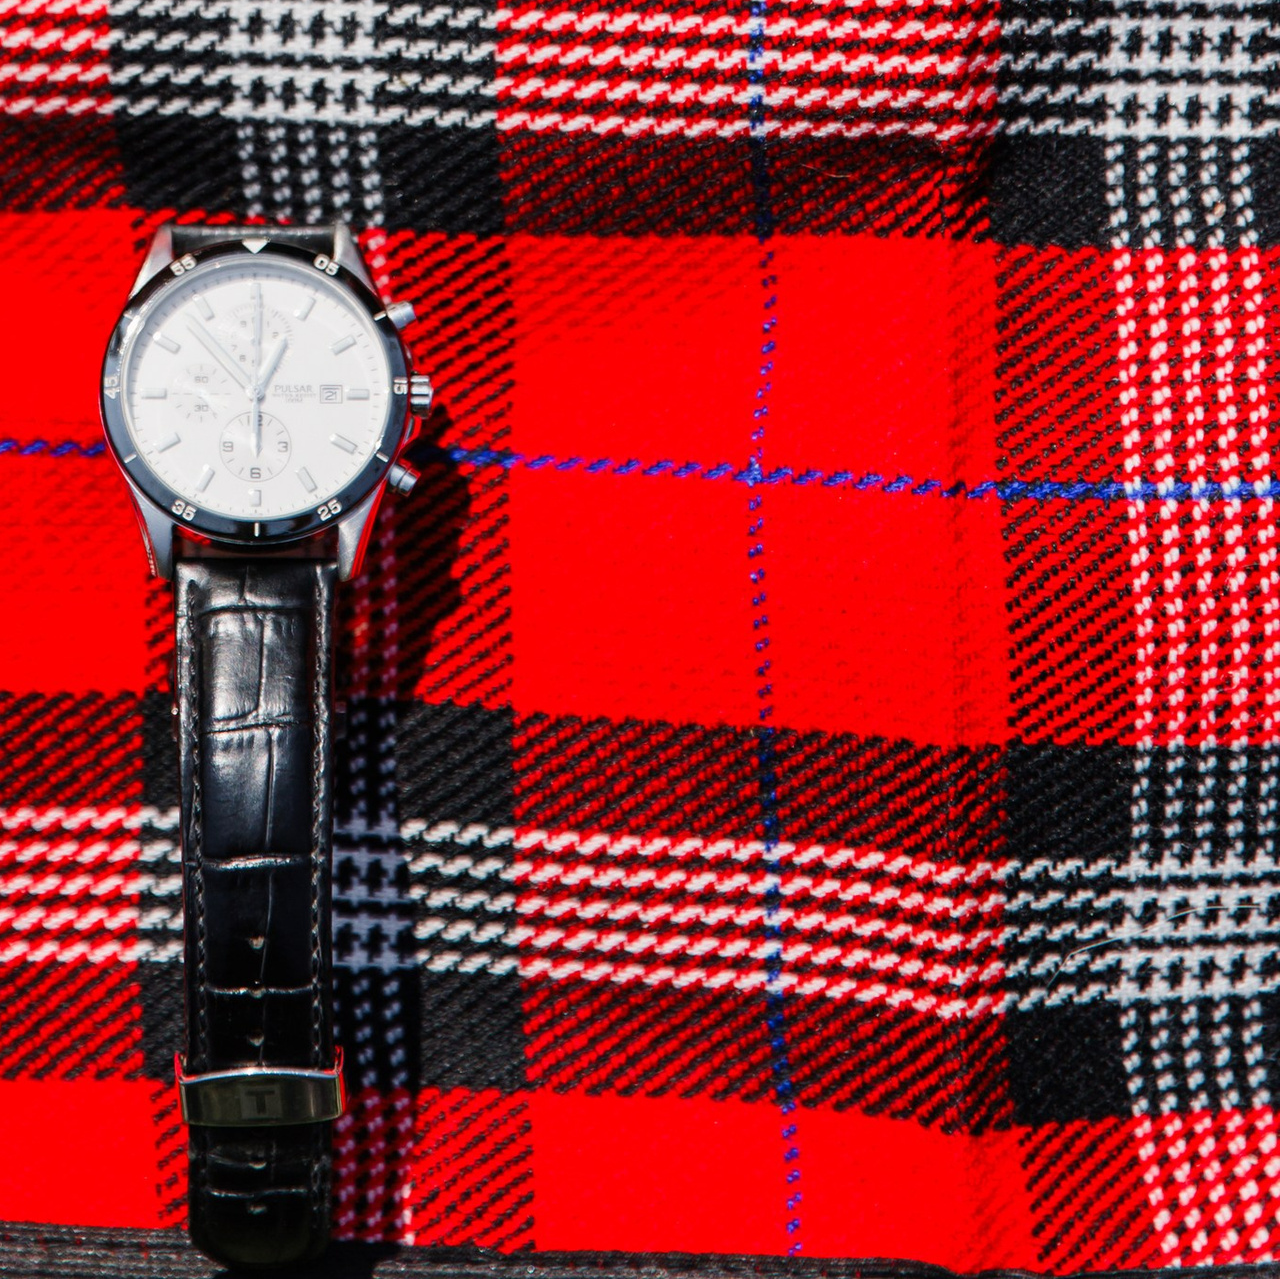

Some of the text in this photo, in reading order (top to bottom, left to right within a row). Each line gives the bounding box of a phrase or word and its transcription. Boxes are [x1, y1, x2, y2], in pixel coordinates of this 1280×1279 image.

[171, 253, 197, 276] 55
[314, 254, 339, 276] 05
[274, 384, 313, 393] PULSAR
[222, 441, 234, 453] 9
[277, 441, 288, 453] 3
[250, 467, 261, 479] 6
[171, 498, 197, 521] 35
[317, 498, 342, 521] 25
